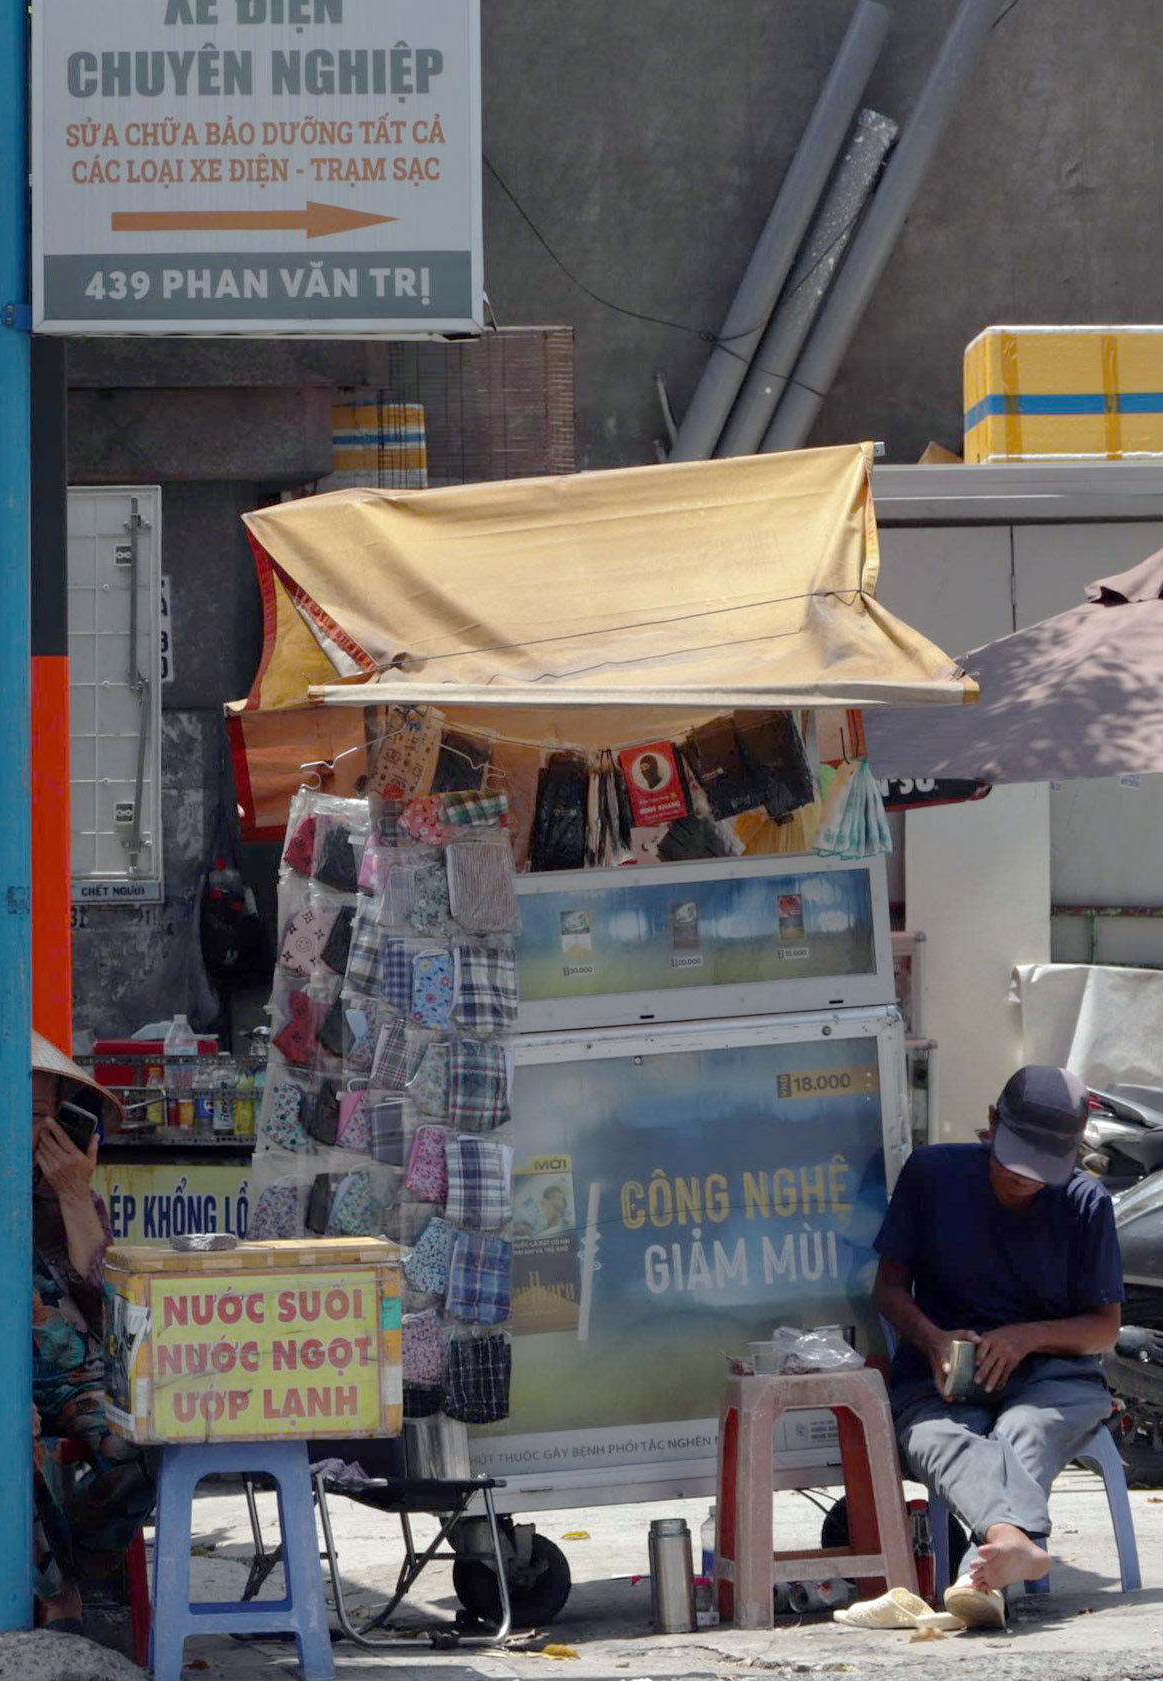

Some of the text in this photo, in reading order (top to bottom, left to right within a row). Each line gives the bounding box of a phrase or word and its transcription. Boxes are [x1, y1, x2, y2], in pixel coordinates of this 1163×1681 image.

[67, 40, 444, 103] CHUYÊN NGHIỆP
[65, 112, 446, 148] SỬA CHỮA BẢO DƯỠNG TẤT CẢ
[72, 154, 121, 184] CÁC
[126, 158, 184, 190] LOẠI
[190, 158, 222, 182] XE
[228, 153, 289, 188] ĐIỆN
[310, 157, 387, 188] TRẠM
[392, 156, 440, 188] SẠC
[85, 261, 430, 306] 439 PHAN VĂN TRỊ
[793, 1073, 851, 1092] 18.000
[144, 1177, 217, 1238] KHỔNG
[621, 1168, 730, 1229] CÔNG
[645, 1228, 748, 1294] GIẢM
[762, 1222, 838, 1285] MÙI
[163, 1279, 362, 1326] NƯỚC SUỐI
[157, 1334, 373, 1377] NƯỚC NGỌT
[173, 1383, 358, 1427] ƯỚP LẠNH
[543, 1447, 568, 1459] GÂY
[571, 1444, 605, 1459] BỆNH
